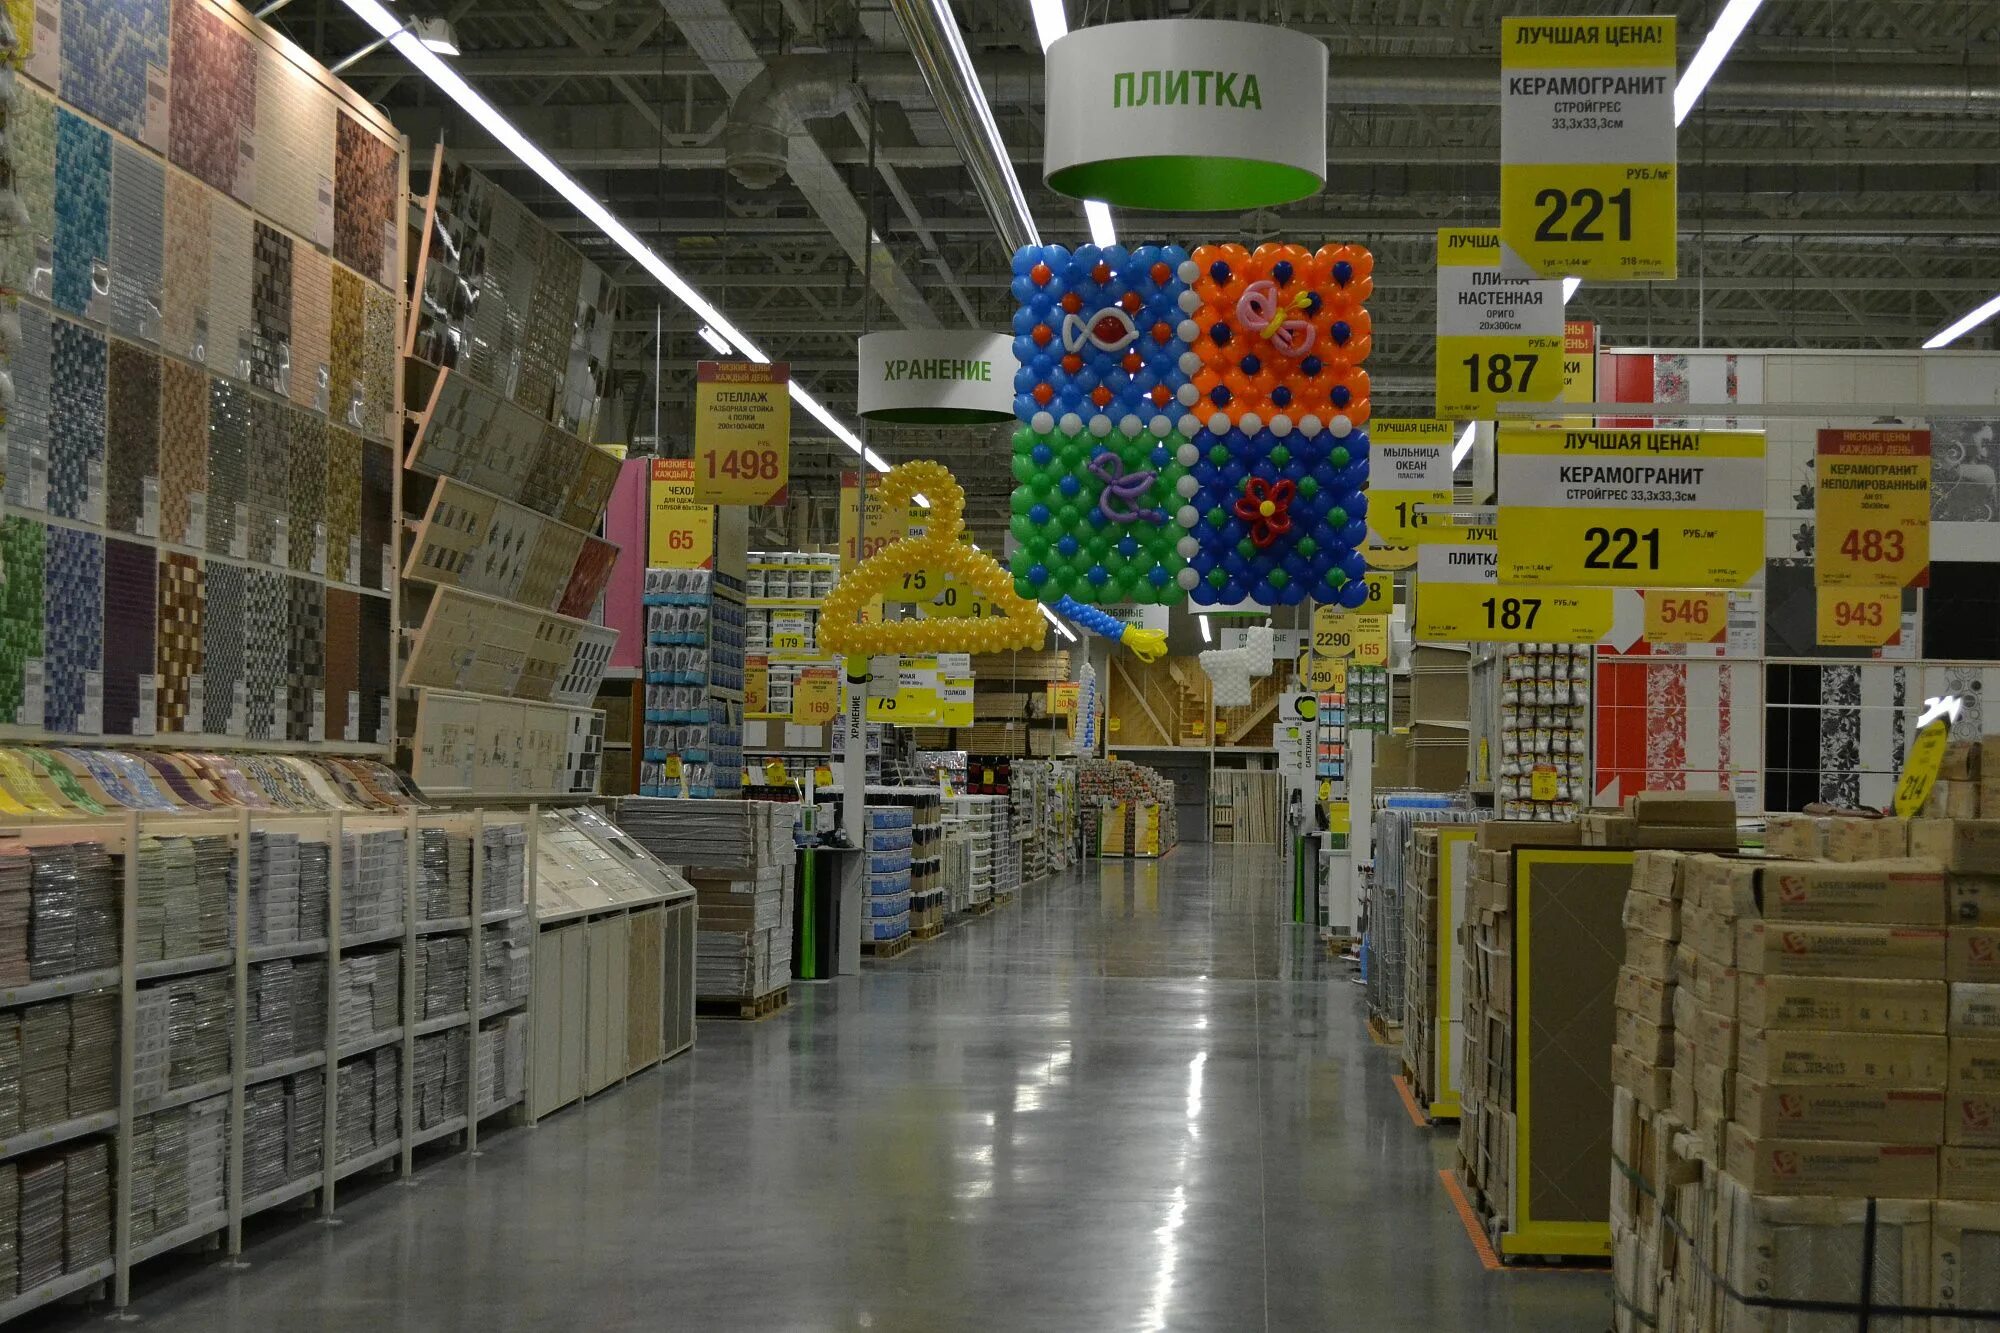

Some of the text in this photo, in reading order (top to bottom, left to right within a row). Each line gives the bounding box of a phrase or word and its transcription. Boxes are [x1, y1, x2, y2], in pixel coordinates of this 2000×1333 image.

[1515, 25, 1663, 47] ЛУЧШАЯ ЦЕНА!
[1113, 70, 1262, 110] ПЛИТКА
[1509, 76, 1667, 96] КЕРАМОГРАНИТ
[1554, 99, 1621, 113] СТРОЙГРЕС
[1534, 187, 1632, 242] 221
[1458, 291, 1543, 305] НАСТЕННАЯ
[1486, 309, 1514, 318] ОРИГО
[884, 358, 991, 381] ХРАНЕНИЕ
[1463, 353, 1539, 394] 187
[716, 392, 768, 402] СТЕЛЛАЖ
[1376, 423, 1448, 434] ЛУЧШАЯ ЦЕНА!
[1564, 433, 1699, 453] ЛУЧШАЯ ЦЕНА!
[1383, 447, 1440, 459] МЫЛЬНИЦА
[658, 460, 687, 469] НИЗКИЕ
[703, 449, 779, 480] 1498
[1396, 460, 1427, 471] ОКЕАН
[1830, 463, 1918, 475] КЕРАМОГРАНИТ
[655, 470, 688, 480] КАЖДЫЙ
[1560, 466, 1704, 485] КЕРАМОГРАНИТ
[1821, 478, 1928, 491] НЕПОЛИРОВАННЫЙ
[1566, 488, 1628, 501] СТРОЙГРЕС
[668, 529, 694, 550] 65
[1840, 529, 1905, 562] 483
[1584, 527, 1660, 570] 221
[1368, 582, 1382, 602] 8
[1482, 597, 1542, 629] 187
[1661, 599, 1709, 625] 546
[1834, 601, 1882, 627] 943
[780, 638, 798, 648] 179
[1316, 632, 1351, 646] 2290
[1358, 643, 1380, 656] 155
[1305, 672, 1331, 683] 490
[809, 701, 830, 713] 169
[851, 695, 860, 739] ХРАНЕНИЕ
